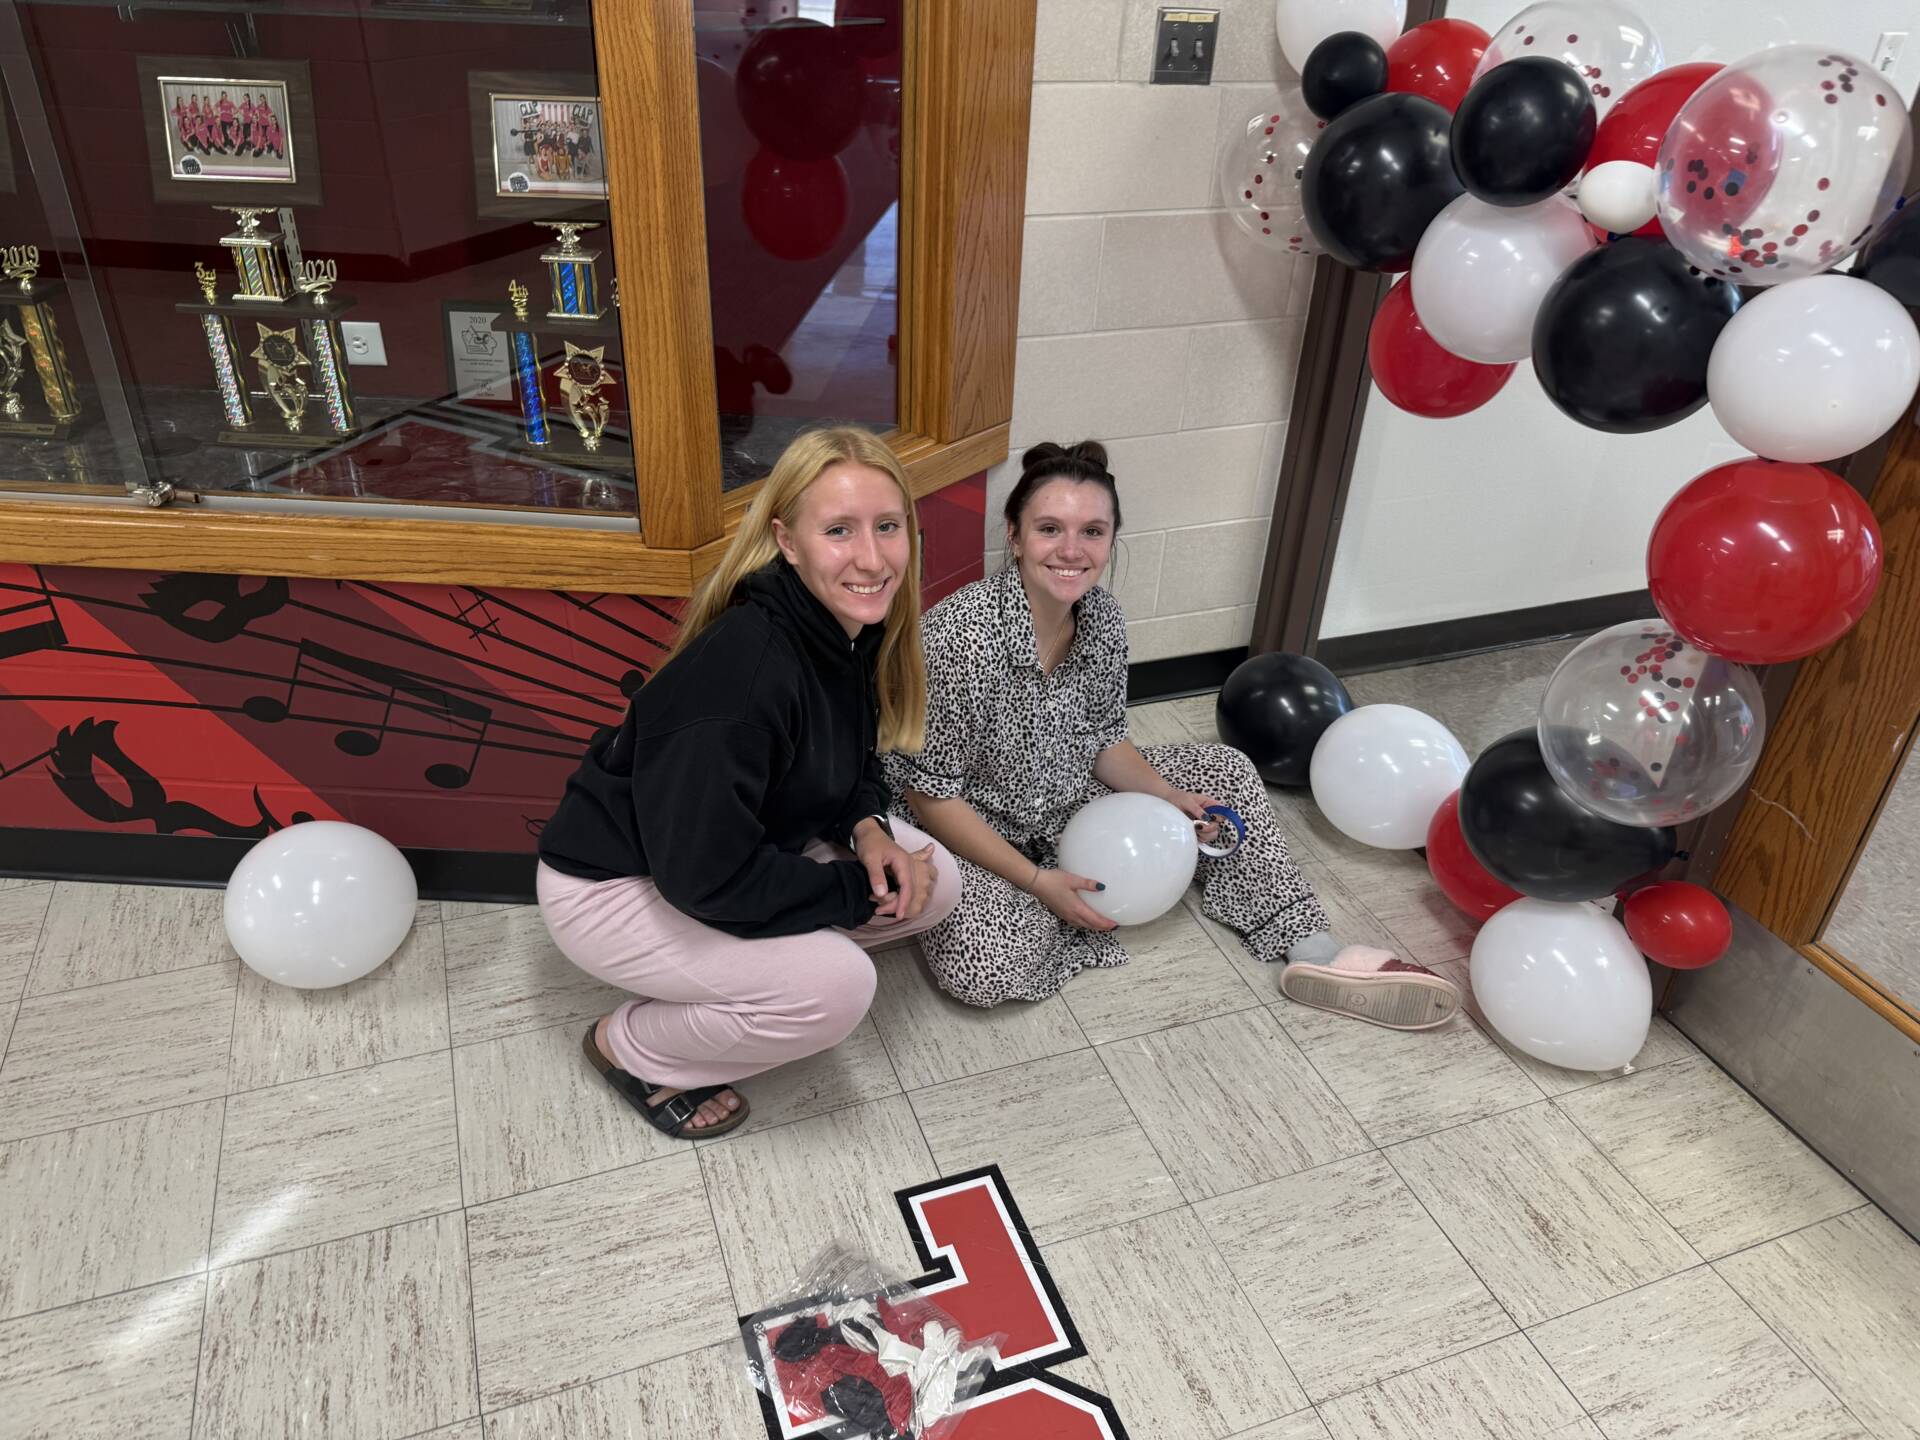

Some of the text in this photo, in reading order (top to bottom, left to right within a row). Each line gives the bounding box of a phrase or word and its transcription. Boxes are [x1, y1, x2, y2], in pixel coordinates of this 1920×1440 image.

[0, 245, 39, 267] 2019
[194, 261, 217, 281] 3rd
[295, 259, 337, 282] 2020
[508, 280, 528, 297] 4th
